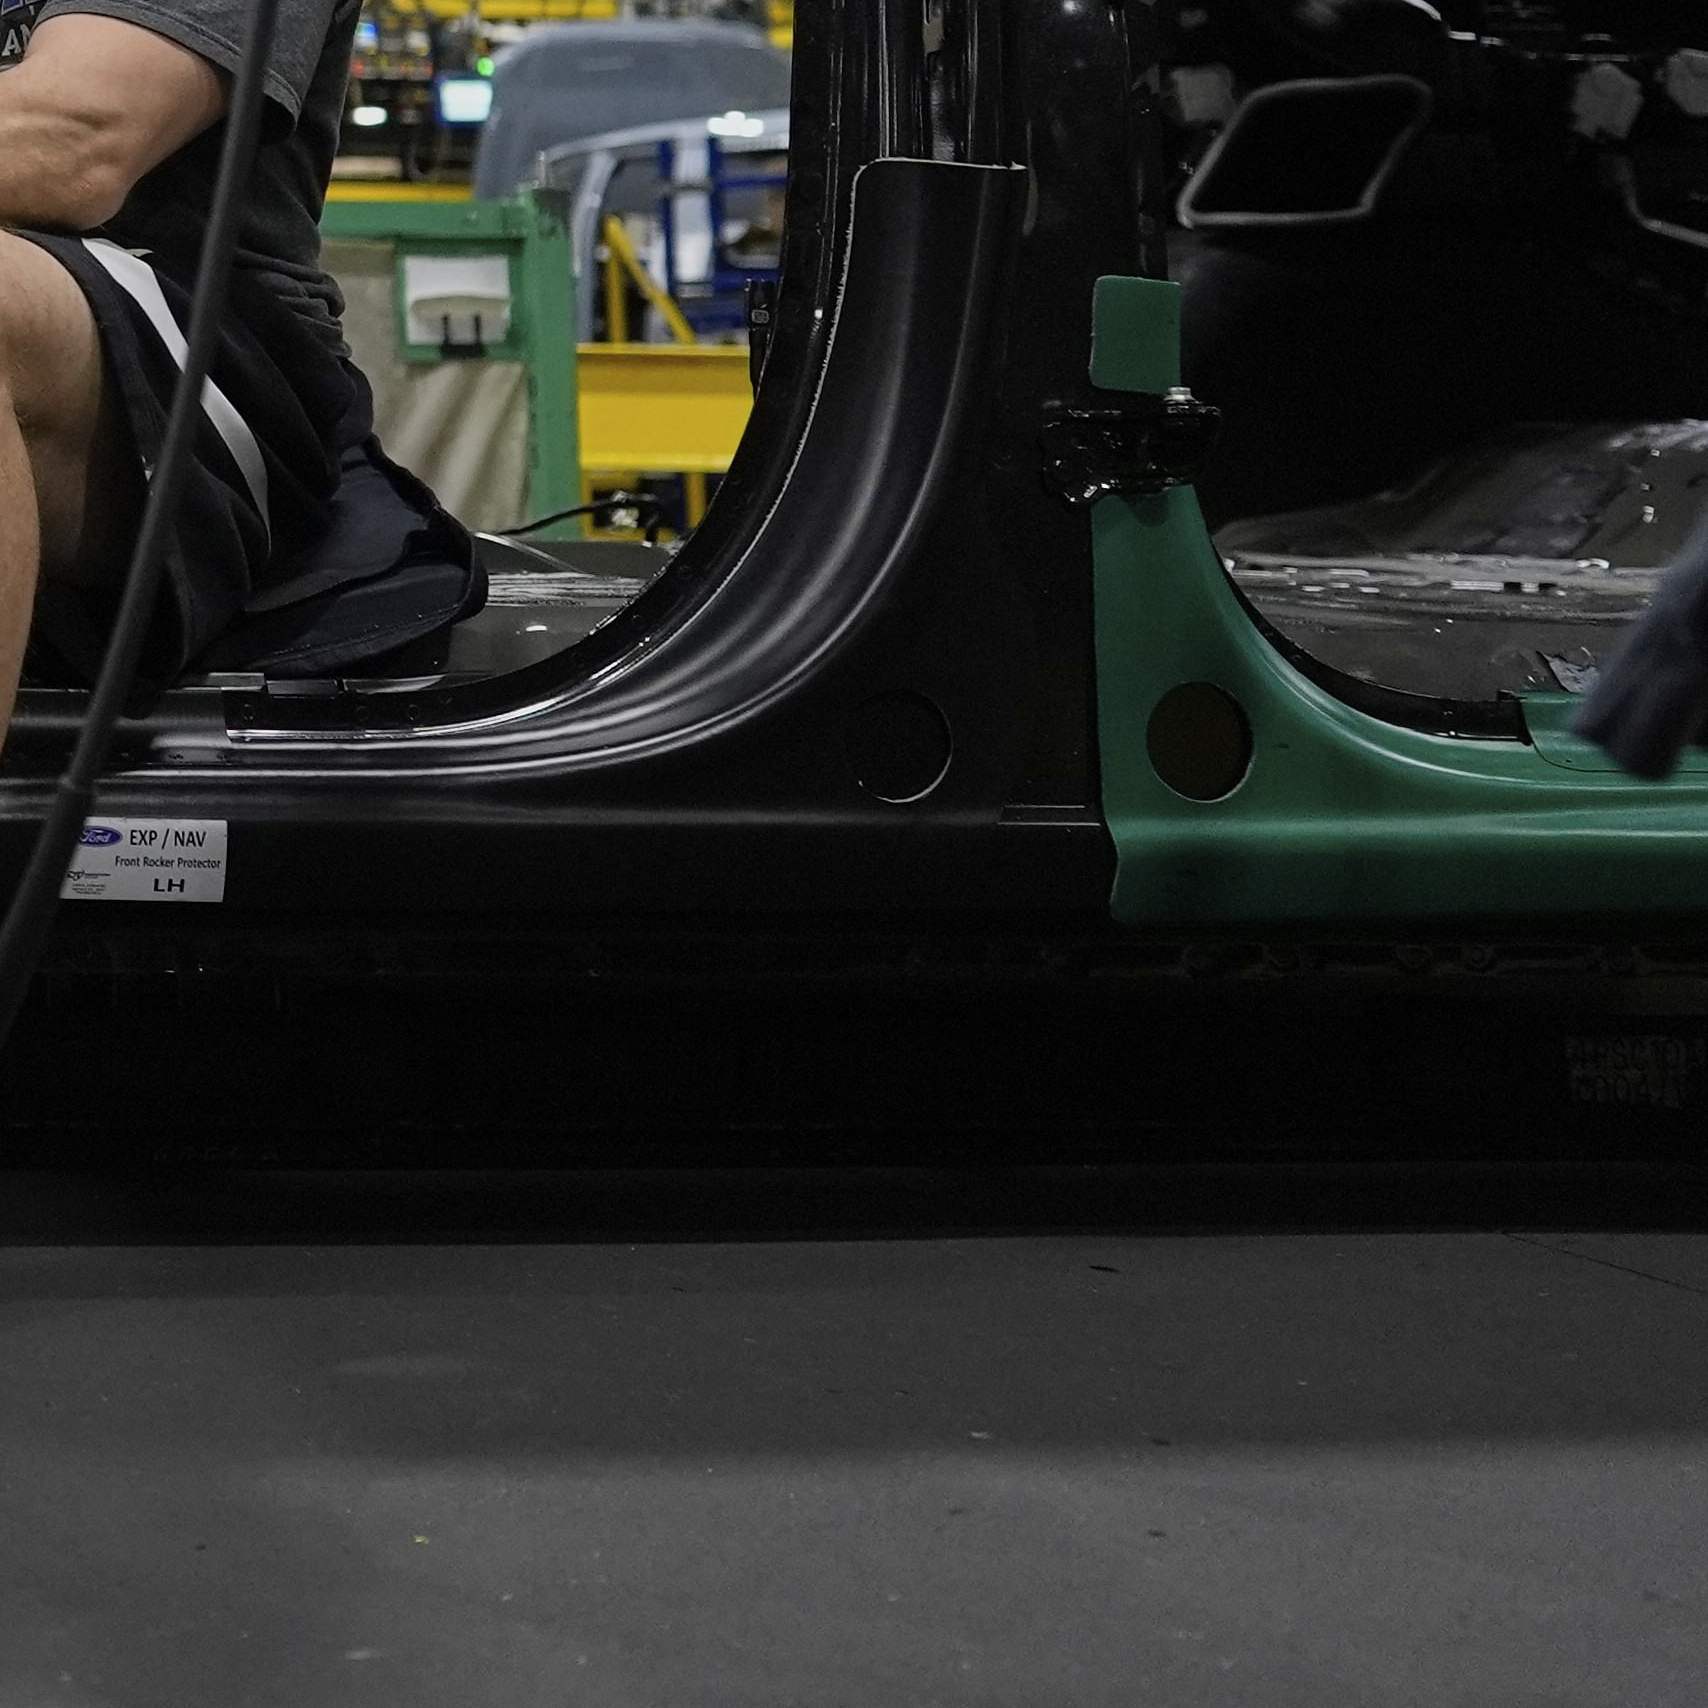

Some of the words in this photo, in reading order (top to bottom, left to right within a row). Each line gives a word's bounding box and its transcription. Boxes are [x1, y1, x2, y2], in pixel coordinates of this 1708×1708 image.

[130, 829, 158, 846] EXP
[174, 831, 206, 847] NAV
[115, 855, 140, 867] Front
[143, 856, 175, 868] Rocker
[177, 857, 221, 869] Protector
[153, 878, 186, 893] LH
